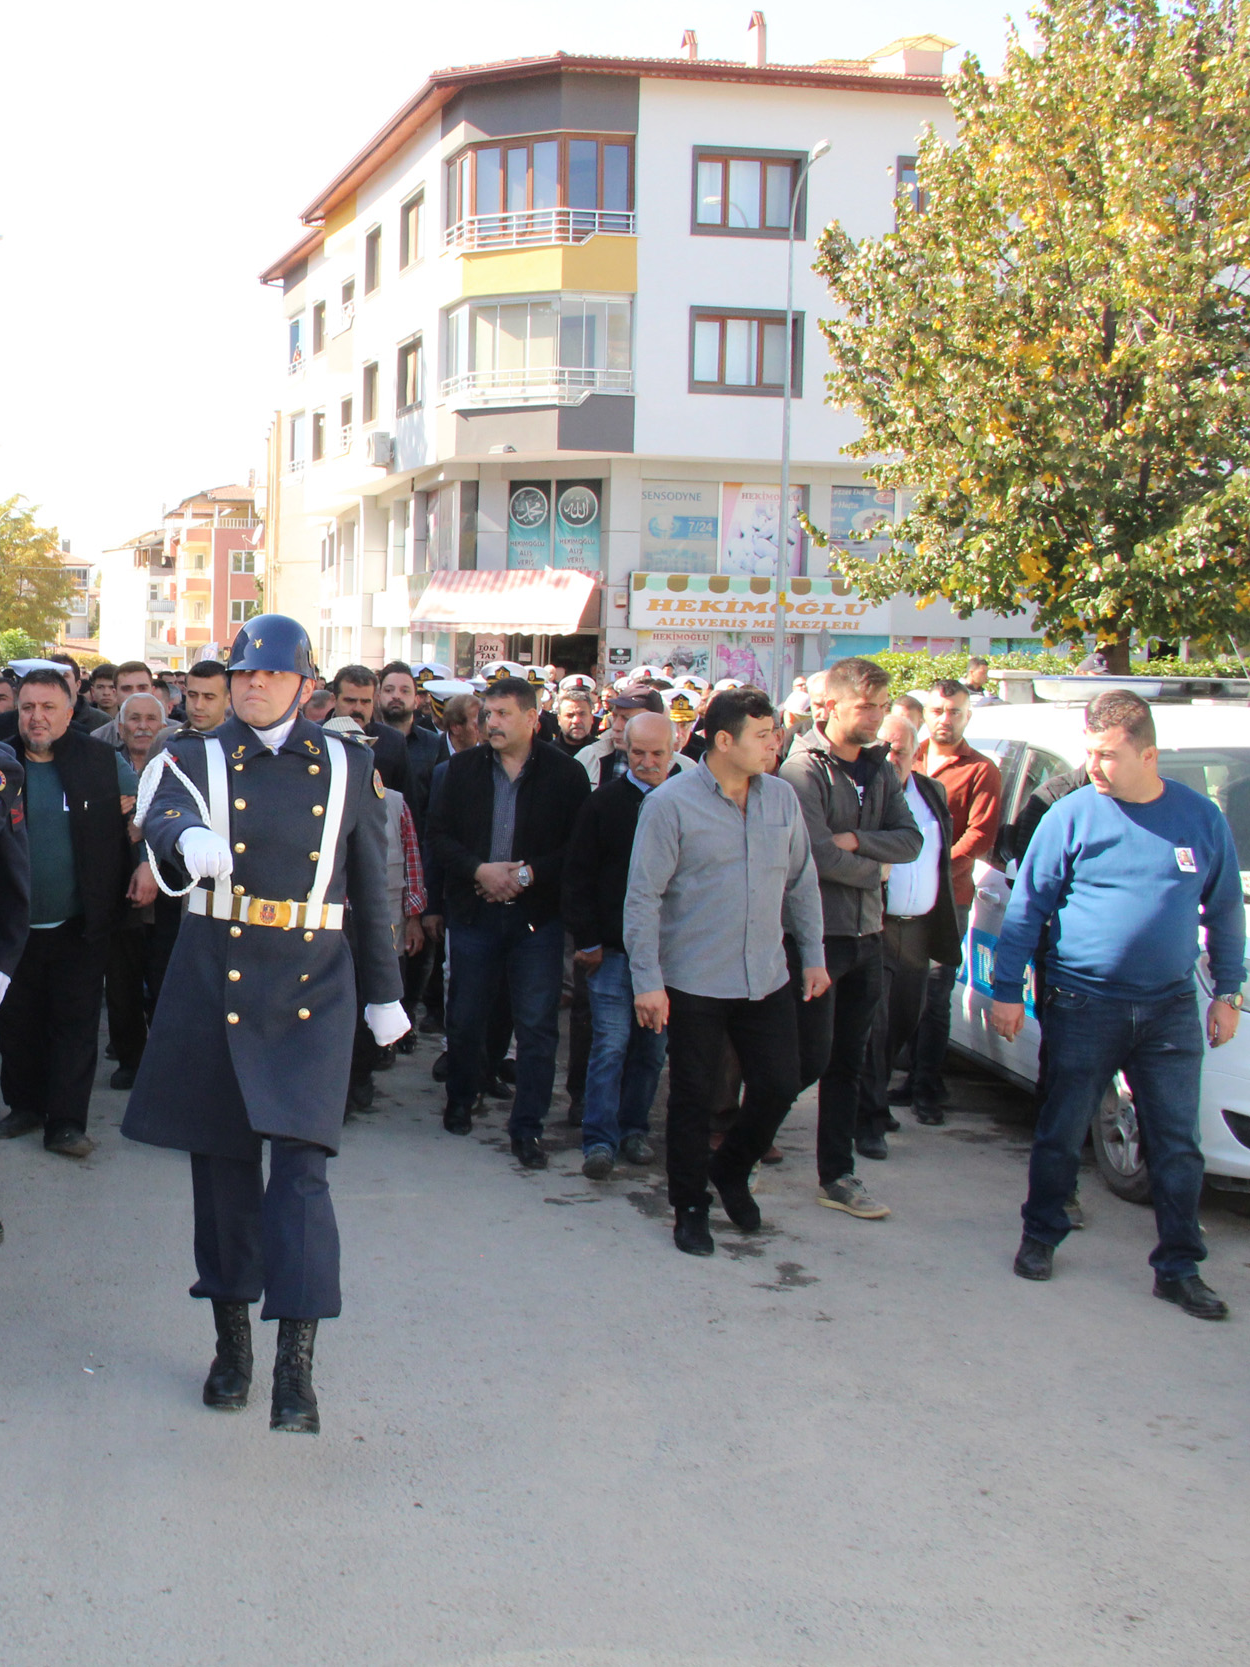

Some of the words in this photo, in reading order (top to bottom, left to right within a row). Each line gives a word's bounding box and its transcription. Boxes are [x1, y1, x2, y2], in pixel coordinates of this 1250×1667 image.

[641, 490, 702, 502] SENSODYNE
[741, 490, 800, 502] HEKİMOLU
[688, 520, 713, 533] 7/24
[646, 597, 871, 617] HEKİMOĞLU
[655, 617, 748, 630] ALIŞVERİŞ
